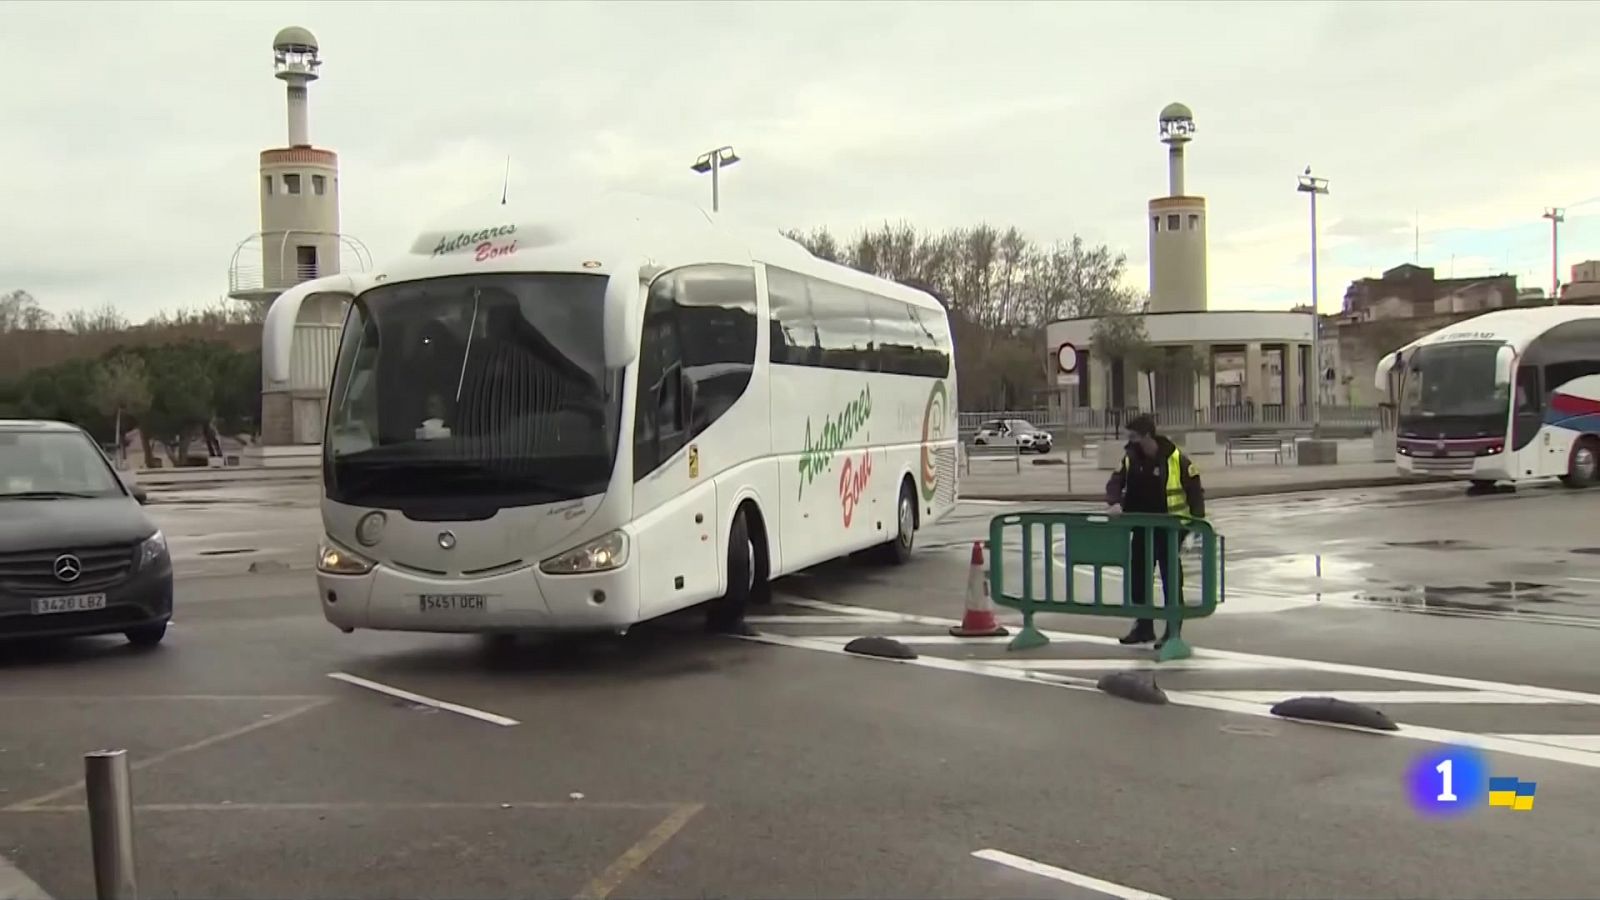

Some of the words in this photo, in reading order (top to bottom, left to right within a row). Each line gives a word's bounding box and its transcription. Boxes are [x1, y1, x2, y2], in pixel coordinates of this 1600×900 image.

[432, 224, 517, 258] Autocares
[475, 239, 518, 262] Boni
[798, 381, 872, 502] Autocares
[839, 430, 872, 528] Boni
